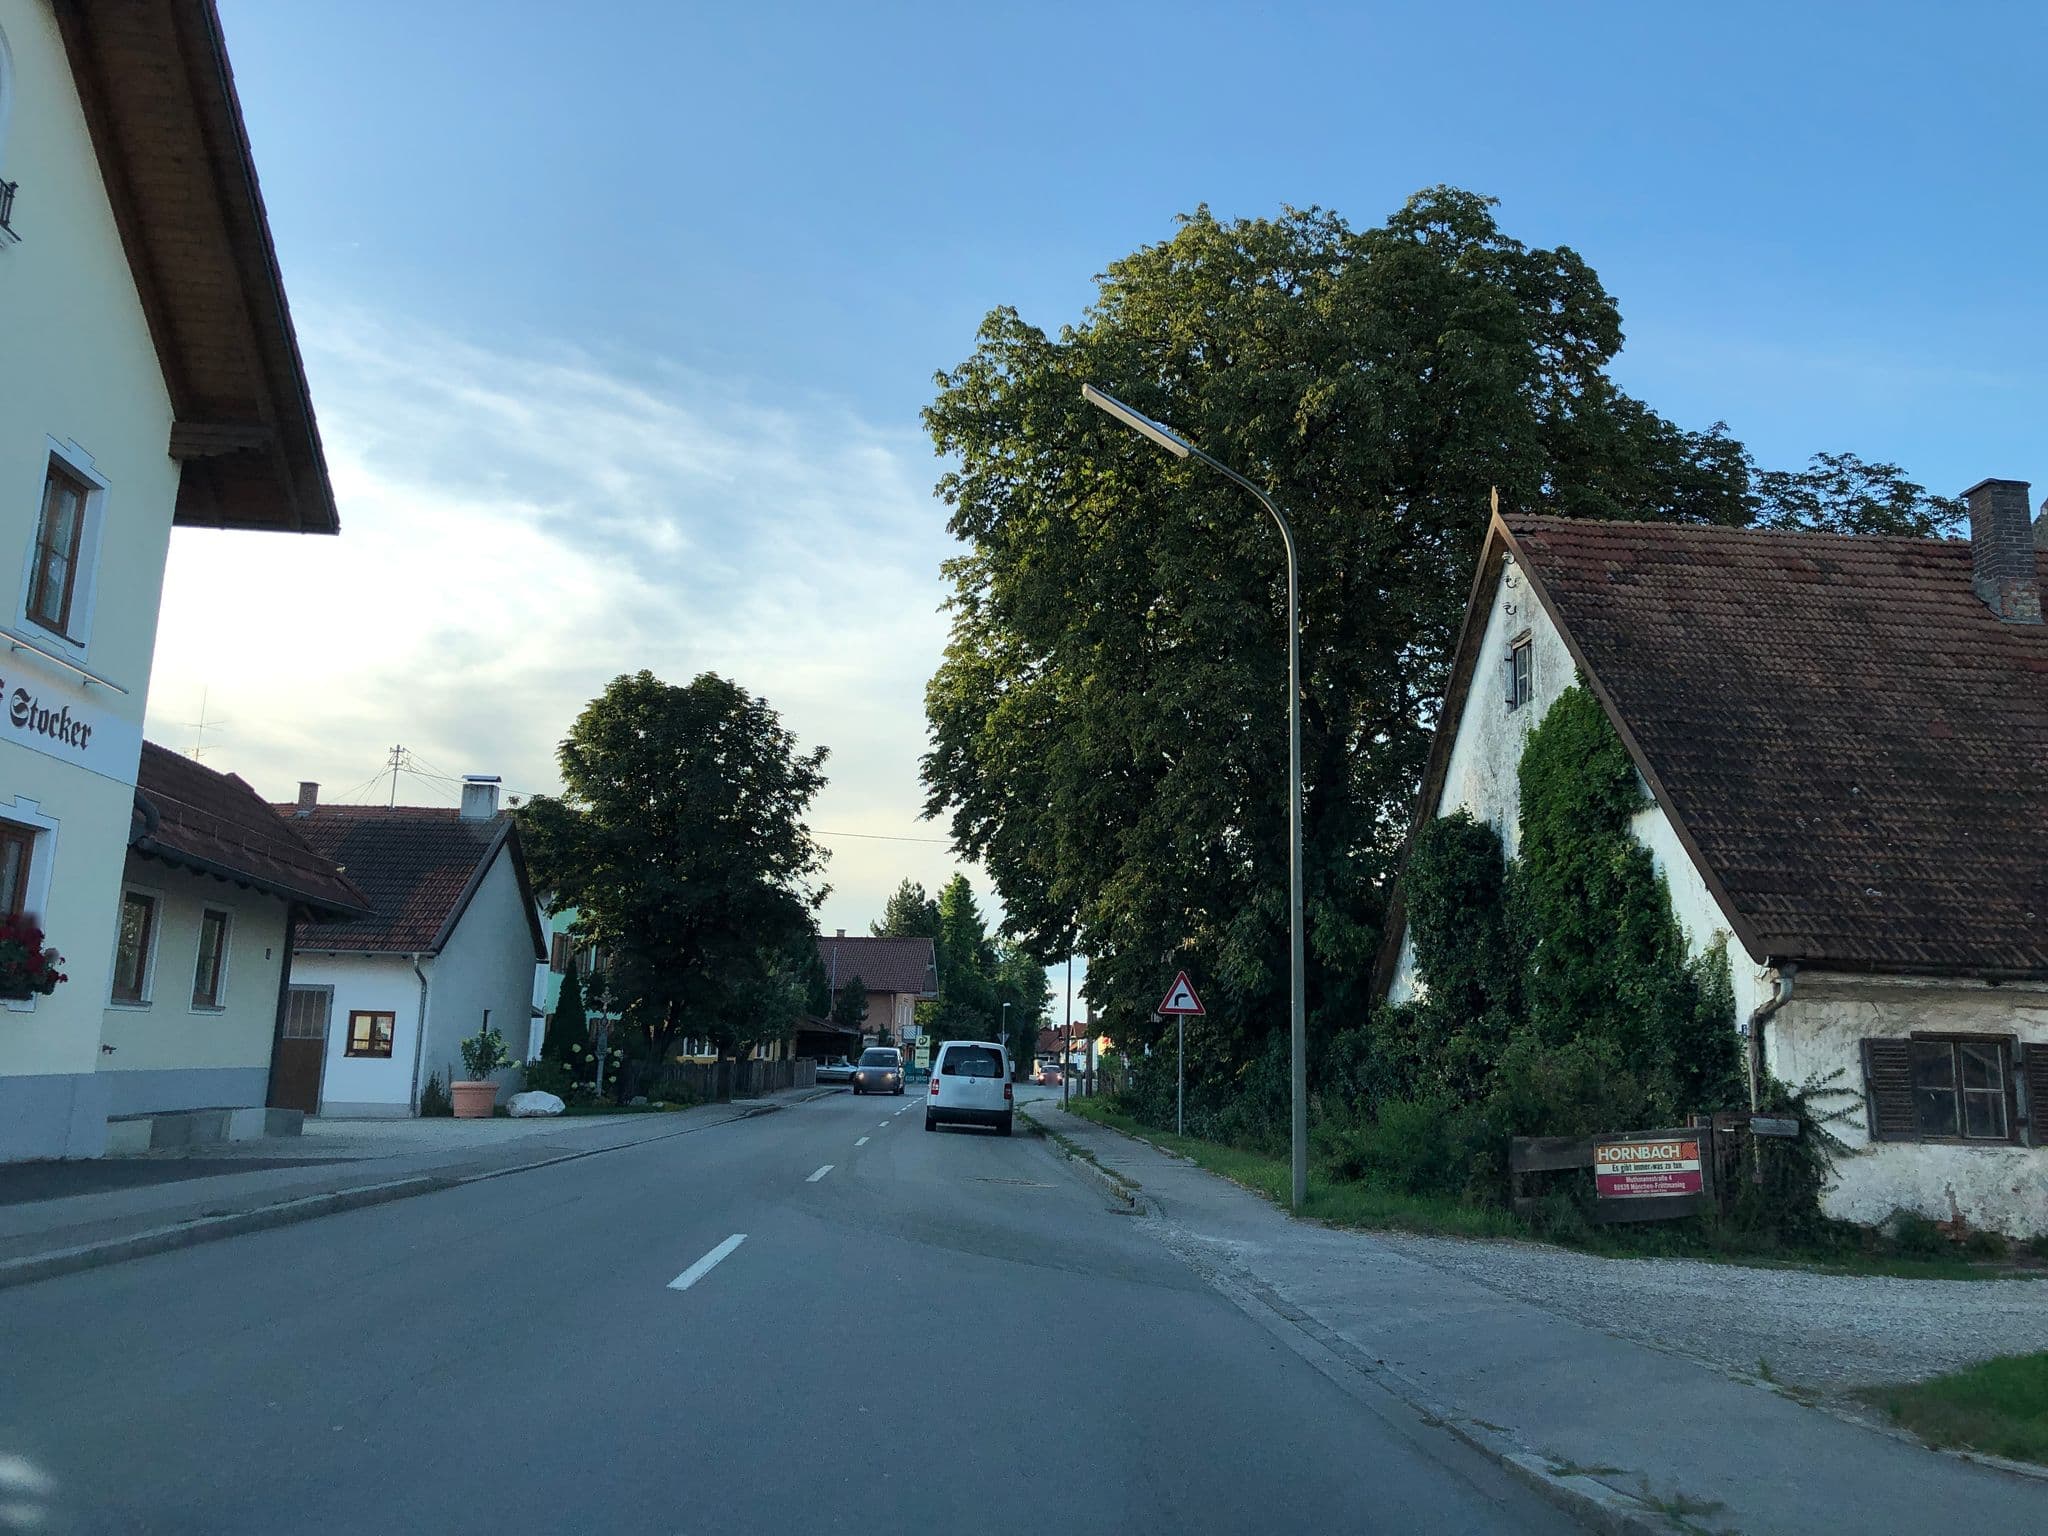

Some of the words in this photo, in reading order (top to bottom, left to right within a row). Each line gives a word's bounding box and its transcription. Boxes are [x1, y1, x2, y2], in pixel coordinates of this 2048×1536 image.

[10, 688, 92, 750] Stocker
[1598, 1145, 1680, 1161] HORNBACH
[1621, 1164, 1632, 1173] gibt
